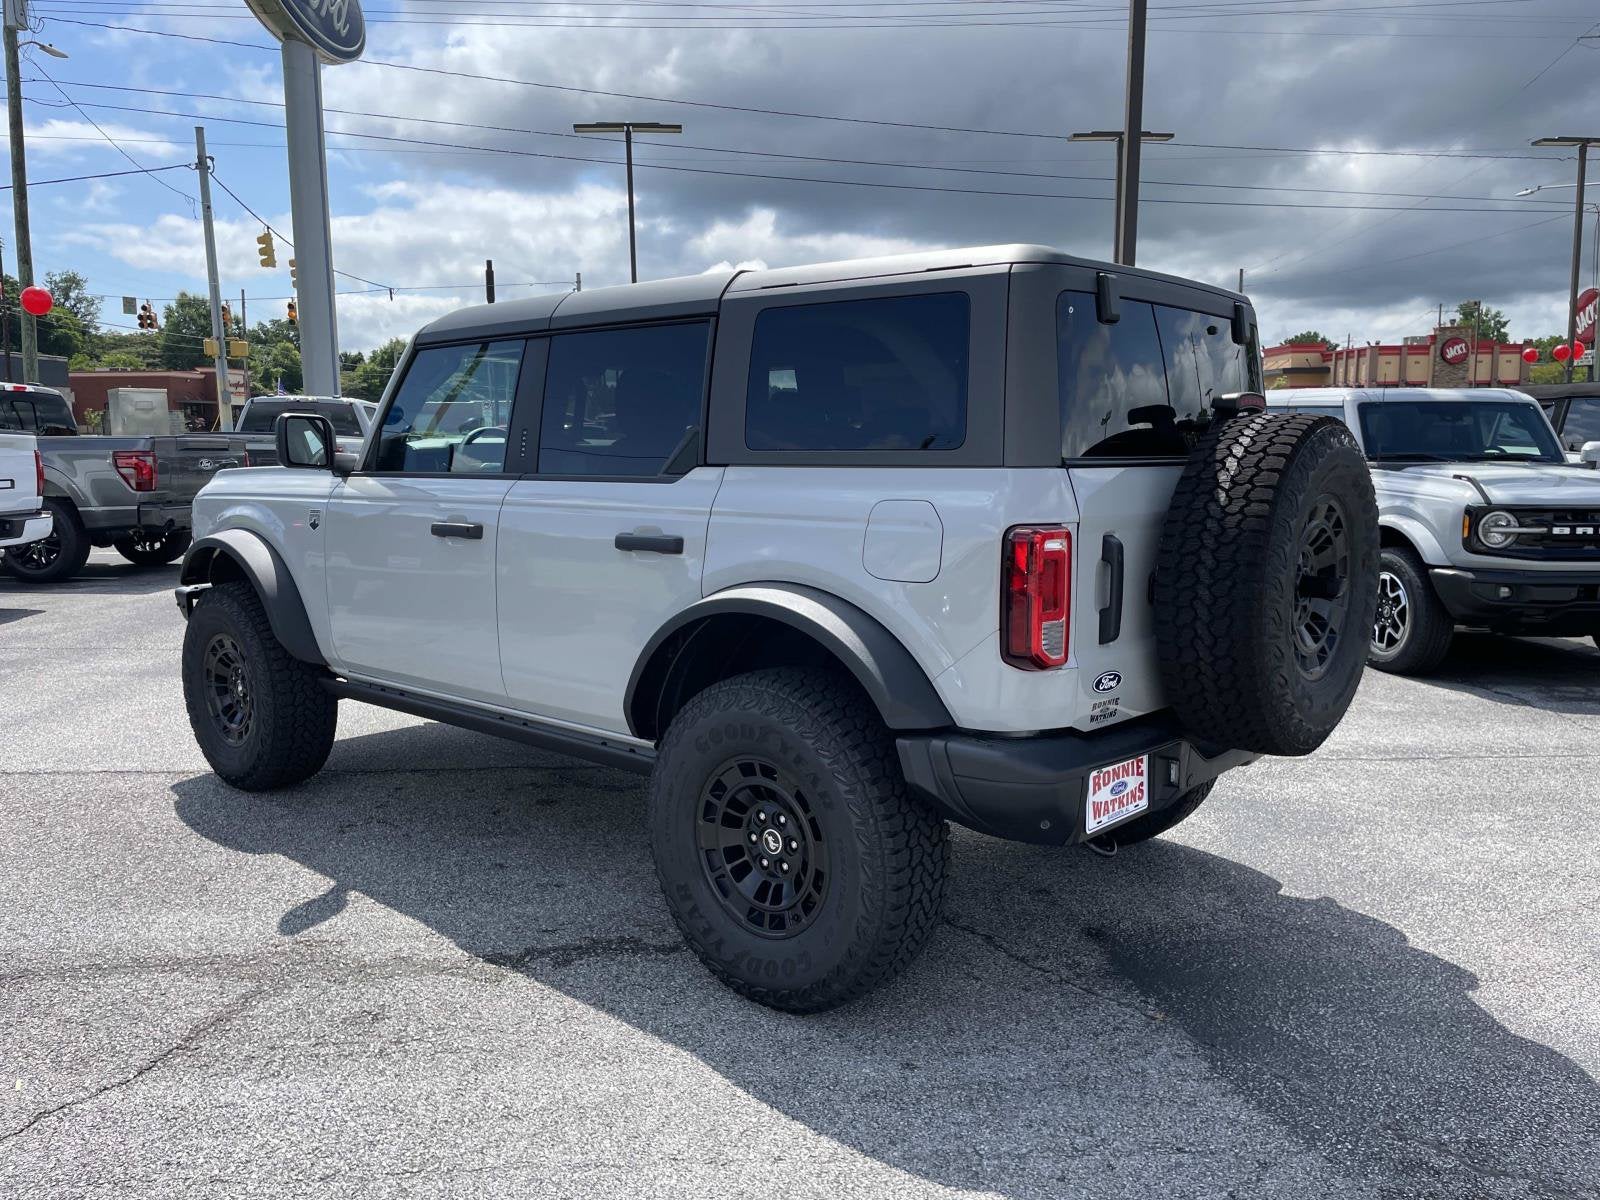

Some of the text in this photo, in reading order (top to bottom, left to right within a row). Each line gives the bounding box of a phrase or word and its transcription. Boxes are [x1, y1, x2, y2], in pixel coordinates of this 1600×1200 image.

[1097, 674, 1119, 691] Ford
[1092, 697, 1119, 711] RONNIE
[1090, 708, 1117, 723] WATKINS
[1092, 758, 1144, 796] RONNIE
[1092, 781, 1144, 820] WATKINS
